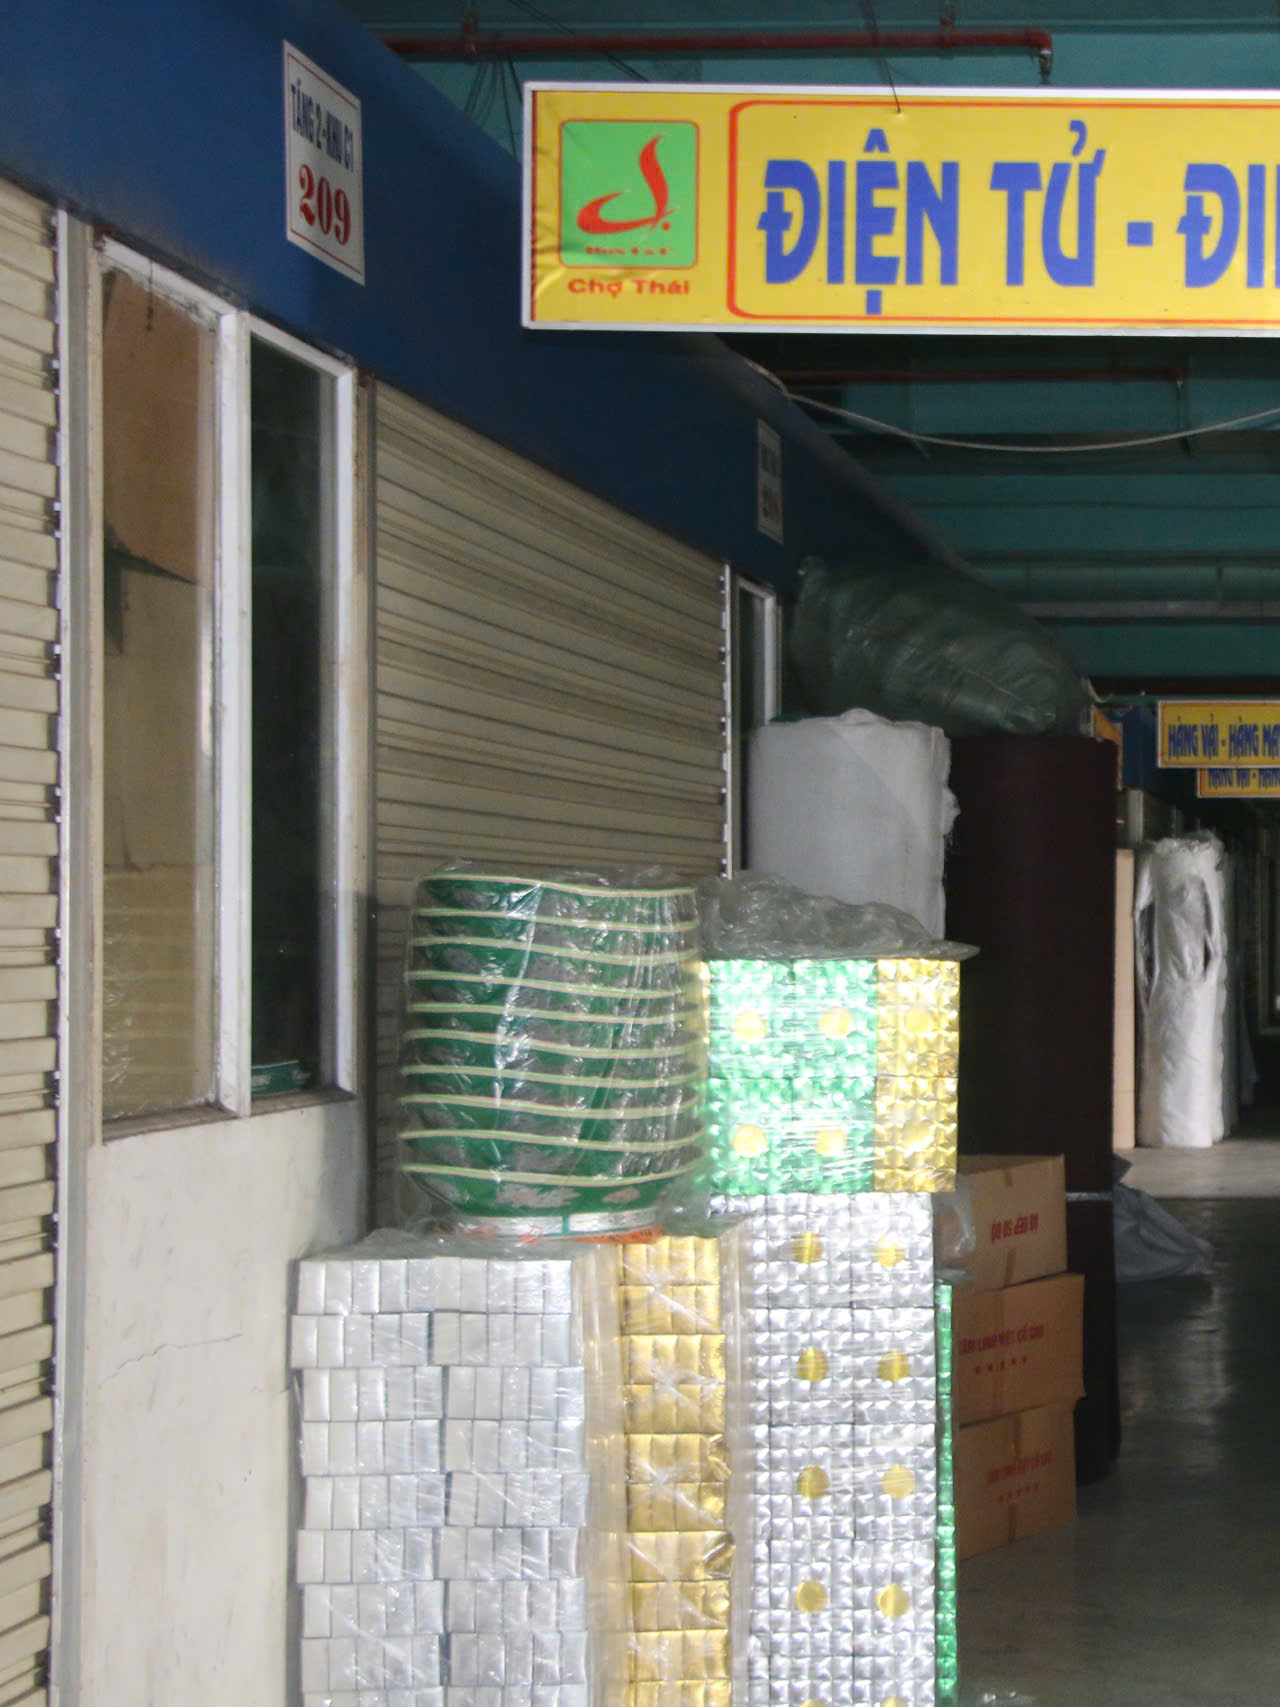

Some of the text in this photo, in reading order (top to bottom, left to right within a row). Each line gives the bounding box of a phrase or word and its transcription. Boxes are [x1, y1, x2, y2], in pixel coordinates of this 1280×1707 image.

[299, 164, 351, 246] 209
[758, 129, 960, 315] ĐIỆN
[989, 119, 1106, 287] TỬ
[567, 277, 690, 300] Chợ Thái
